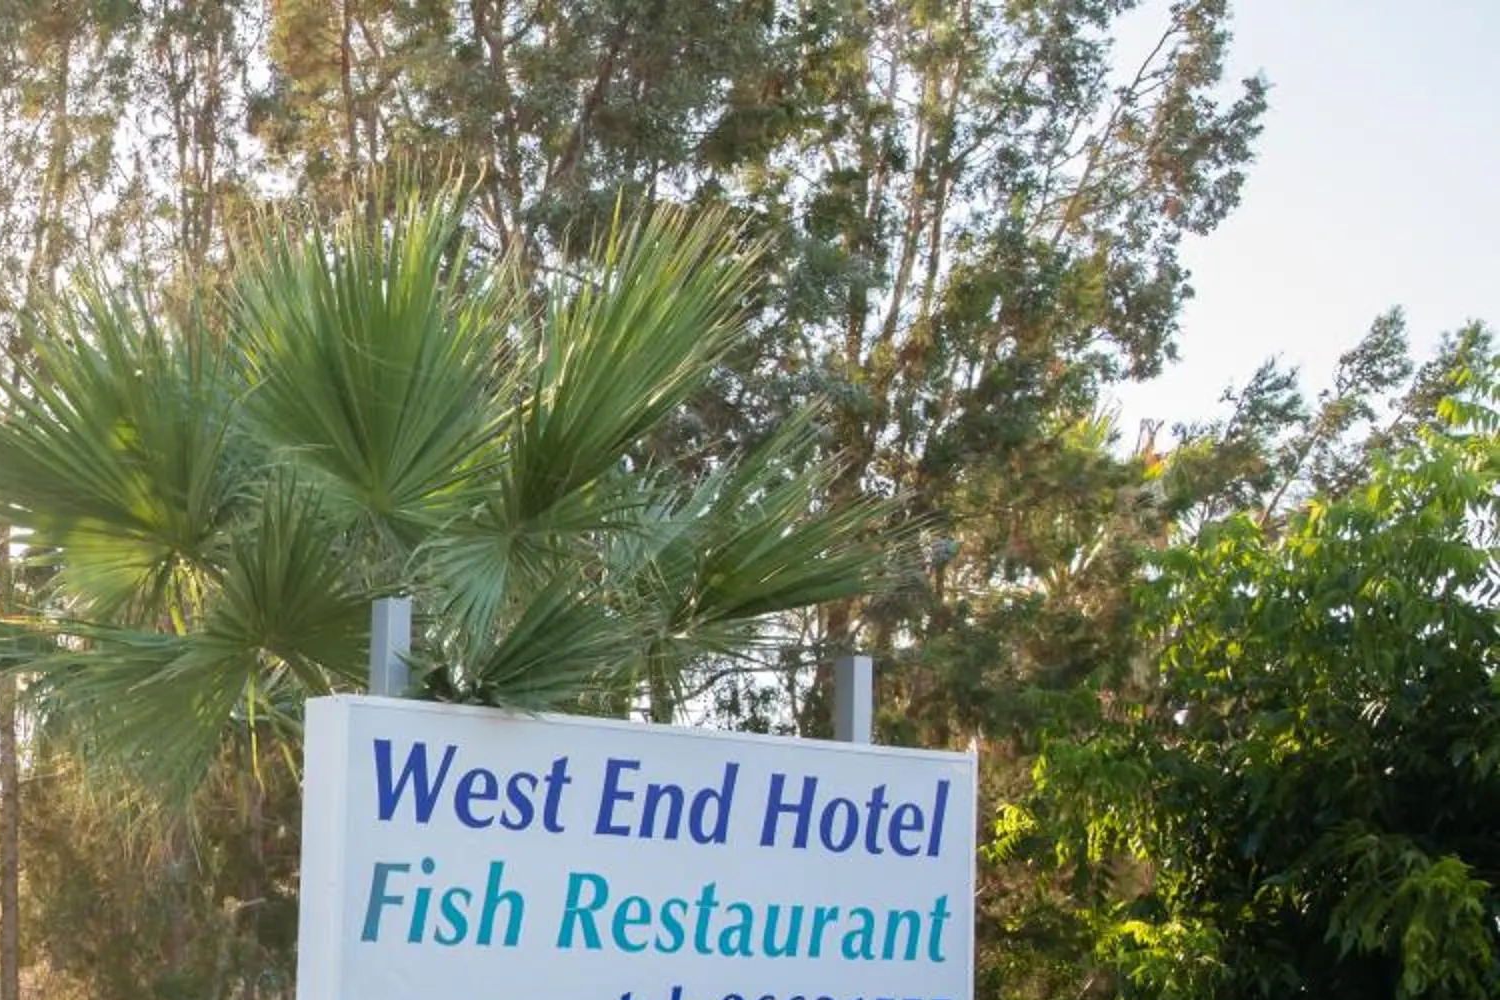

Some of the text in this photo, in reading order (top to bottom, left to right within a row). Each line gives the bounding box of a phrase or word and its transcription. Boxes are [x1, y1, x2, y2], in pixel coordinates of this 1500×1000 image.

[371, 738, 950, 857] West End Hotel
[360, 857, 951, 963] Fish Restaurant
